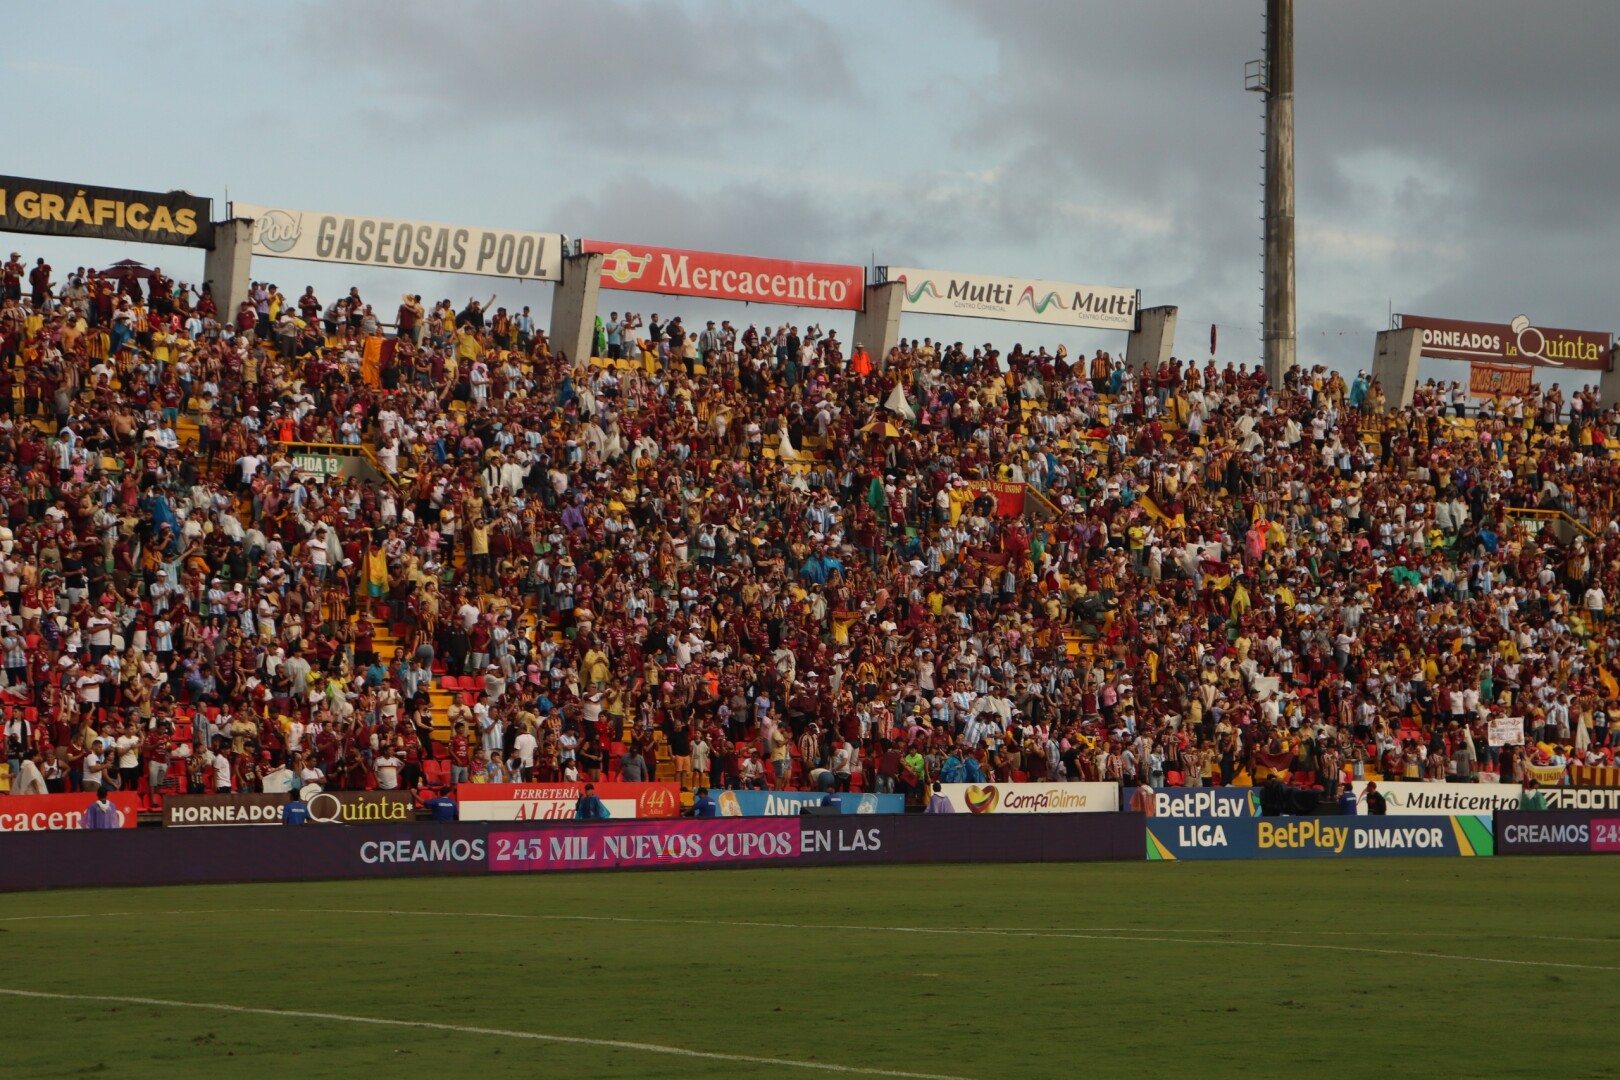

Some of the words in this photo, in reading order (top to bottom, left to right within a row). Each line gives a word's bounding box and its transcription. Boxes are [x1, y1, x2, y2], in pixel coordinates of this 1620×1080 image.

[14, 189, 198, 235] GRÁFICAS
[253, 213, 302, 246] Pool
[316, 216, 469, 270] GASEOSAS
[476, 231, 547, 277] POOL
[947, 279, 1013, 305] Multi
[1071, 291, 1136, 316] Multi
[1423, 329, 1500, 351] ORNEADOS
[1516, 327, 1599, 365] Quinta
[292, 455, 323, 473] ALIDA
[325, 457, 338, 473] 13
[513, 786, 580, 800] FERRETERÍA
[646, 790, 665, 807] 44
[1004, 789, 1087, 811] ComfaTolima
[1406, 792, 1519, 811] Multicentro
[171, 805, 284, 822] HORNEADOS
[307, 793, 407, 823] Quinta
[514, 802, 537, 821] Al
[359, 839, 486, 864] CREAMOS
[496, 838, 542, 861] 245
[549, 836, 596, 861] MIL
[603, 832, 703, 860] NUEVOS
[709, 832, 792, 858] CUPOS
[801, 829, 831, 852] EN
[839, 828, 881, 851] LAS
[1179, 825, 1228, 847] LIGA
[1258, 818, 1349, 853] BetPlay
[1354, 828, 1444, 849] DIMAYOR
[1504, 824, 1589, 843] CREAMOS
